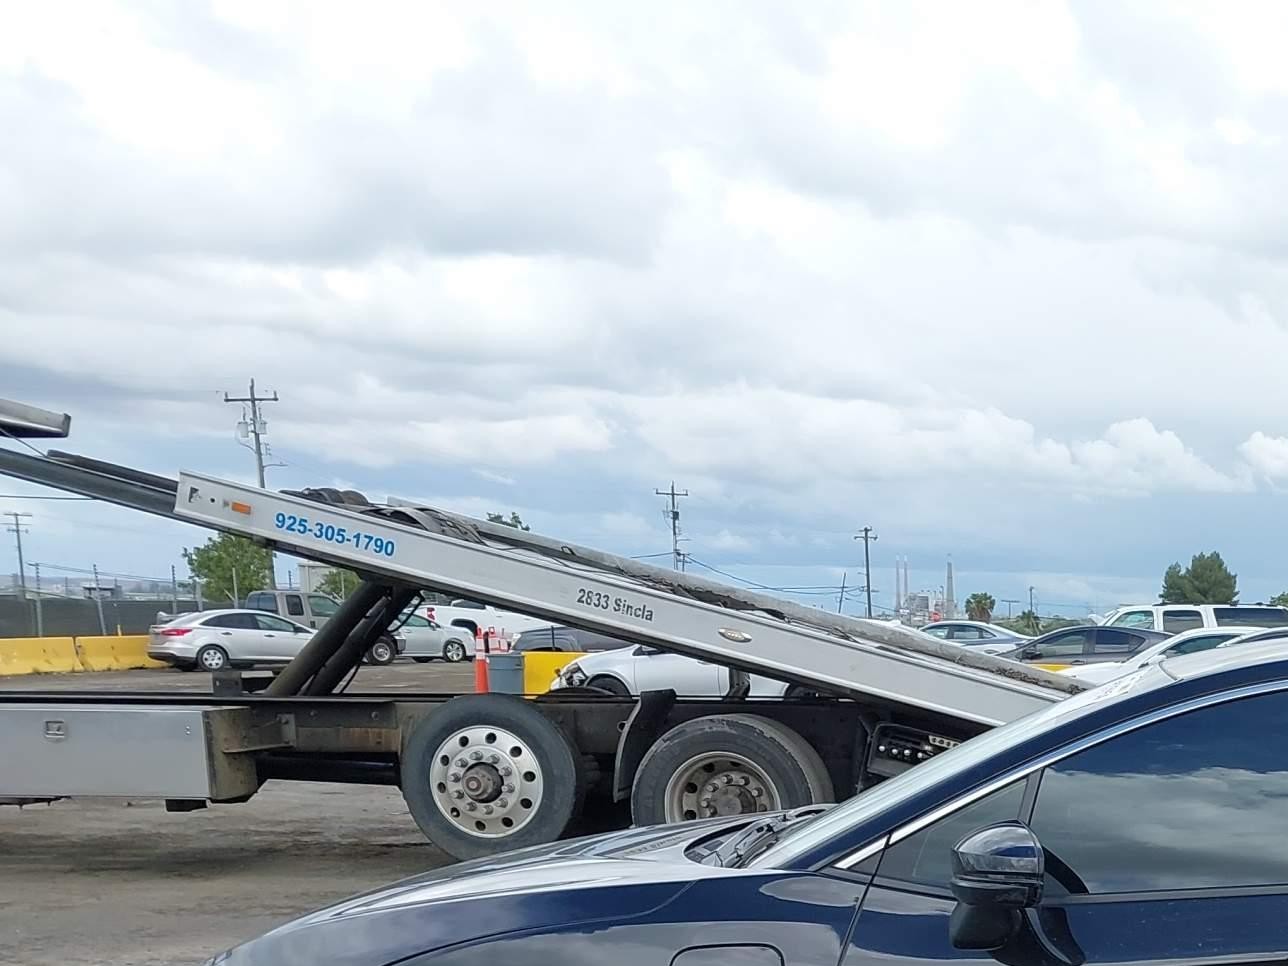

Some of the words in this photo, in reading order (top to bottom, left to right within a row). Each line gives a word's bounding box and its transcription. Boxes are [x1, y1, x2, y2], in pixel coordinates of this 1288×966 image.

[275, 513, 395, 556] 925-305-1790
[576, 588, 610, 610] 2833
[613, 597, 654, 621] Sincla
